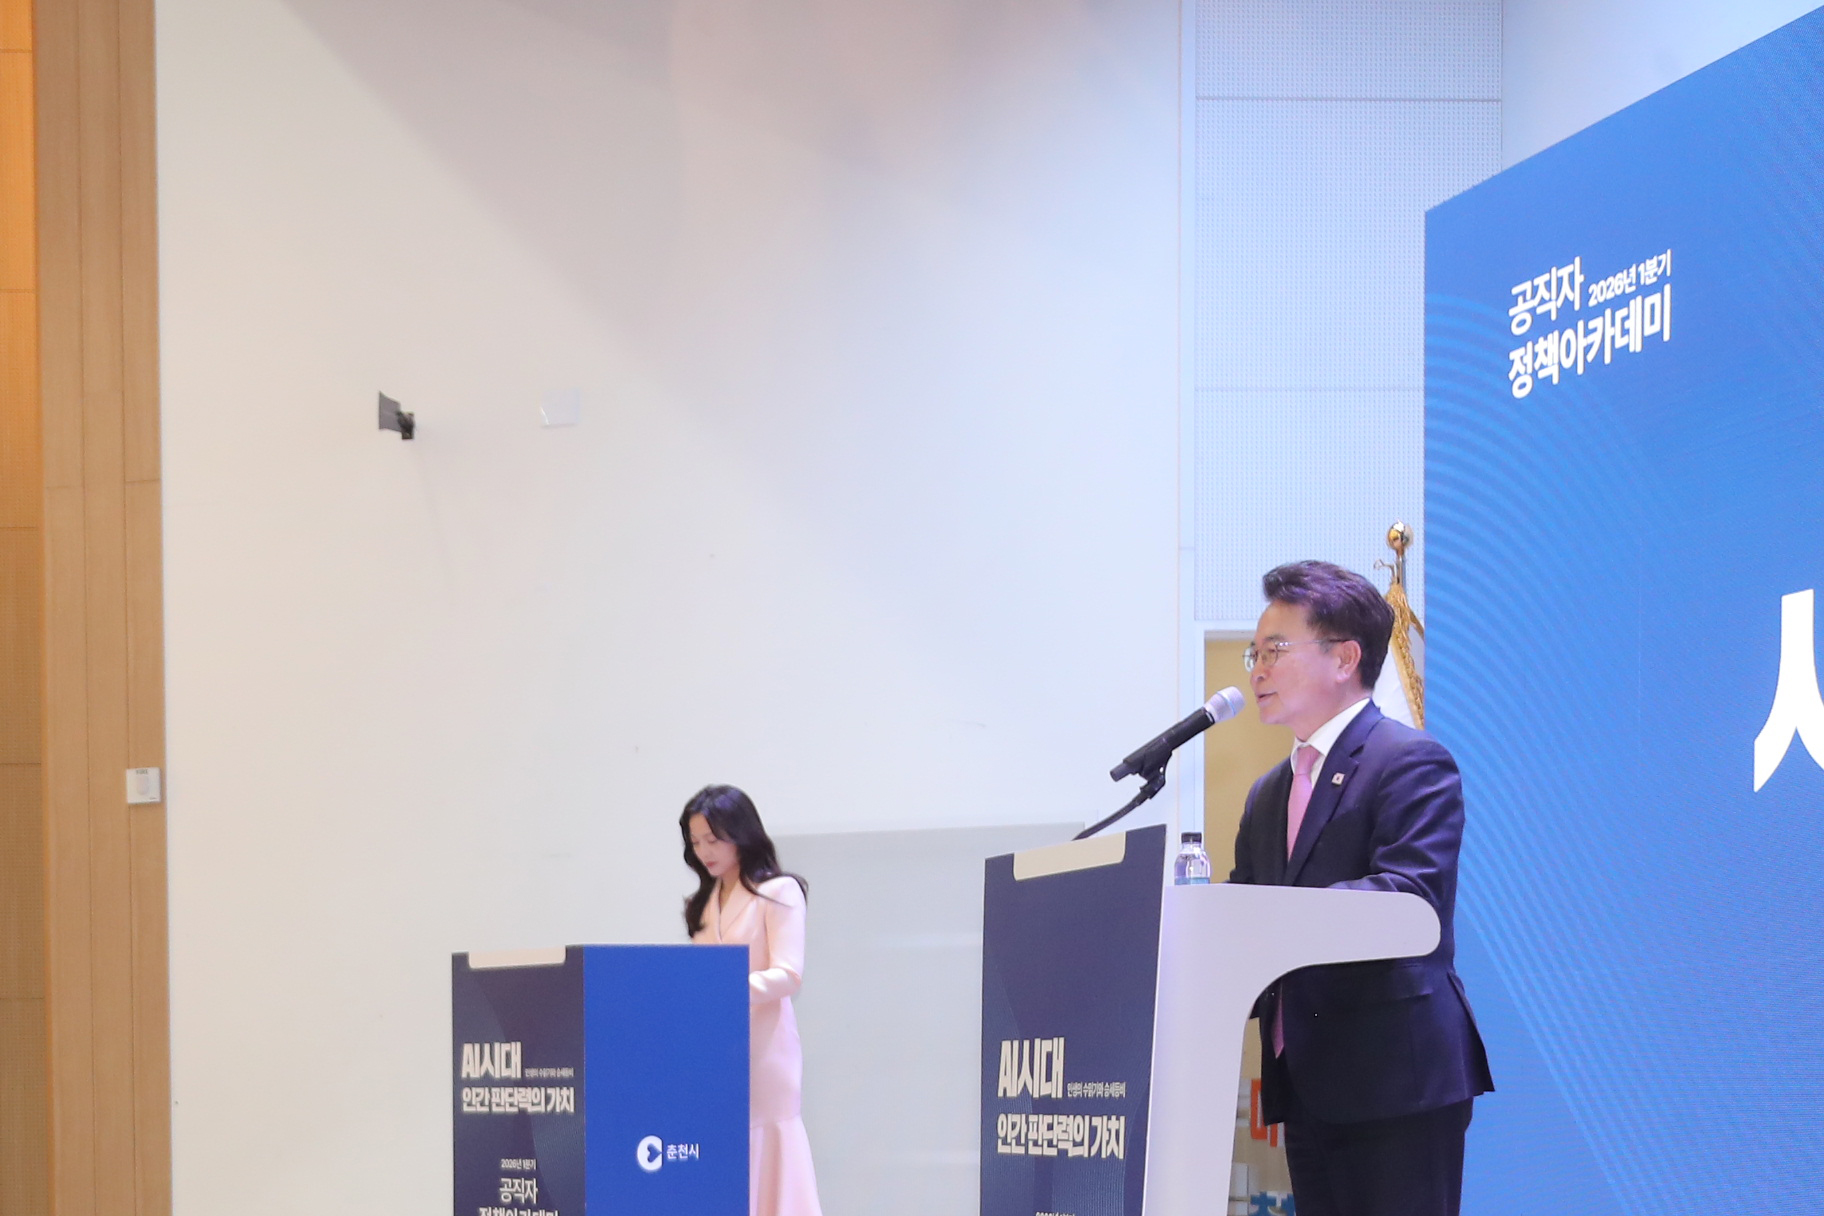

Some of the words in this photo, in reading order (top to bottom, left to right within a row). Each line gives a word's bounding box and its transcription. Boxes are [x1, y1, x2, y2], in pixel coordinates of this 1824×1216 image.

[1508, 256, 1585, 336] 공직자
[1588, 264, 1637, 308] 2026년
[1638, 249, 1672, 287] 1분기
[1508, 283, 1672, 399] 정책아카데미
[461, 1041, 522, 1079] AI시대
[997, 1037, 1065, 1098] AI시대
[462, 1086, 490, 1113] 인간
[491, 1086, 545, 1113] 판단력의
[546, 1086, 575, 1113] 가치
[666, 1144, 700, 1160] 춘천시
[997, 1113, 1027, 1154] 인간
[1027, 1113, 1090, 1158] 판단력의
[1090, 1115, 1126, 1160] 가치
[499, 1177, 539, 1204] 공직자
